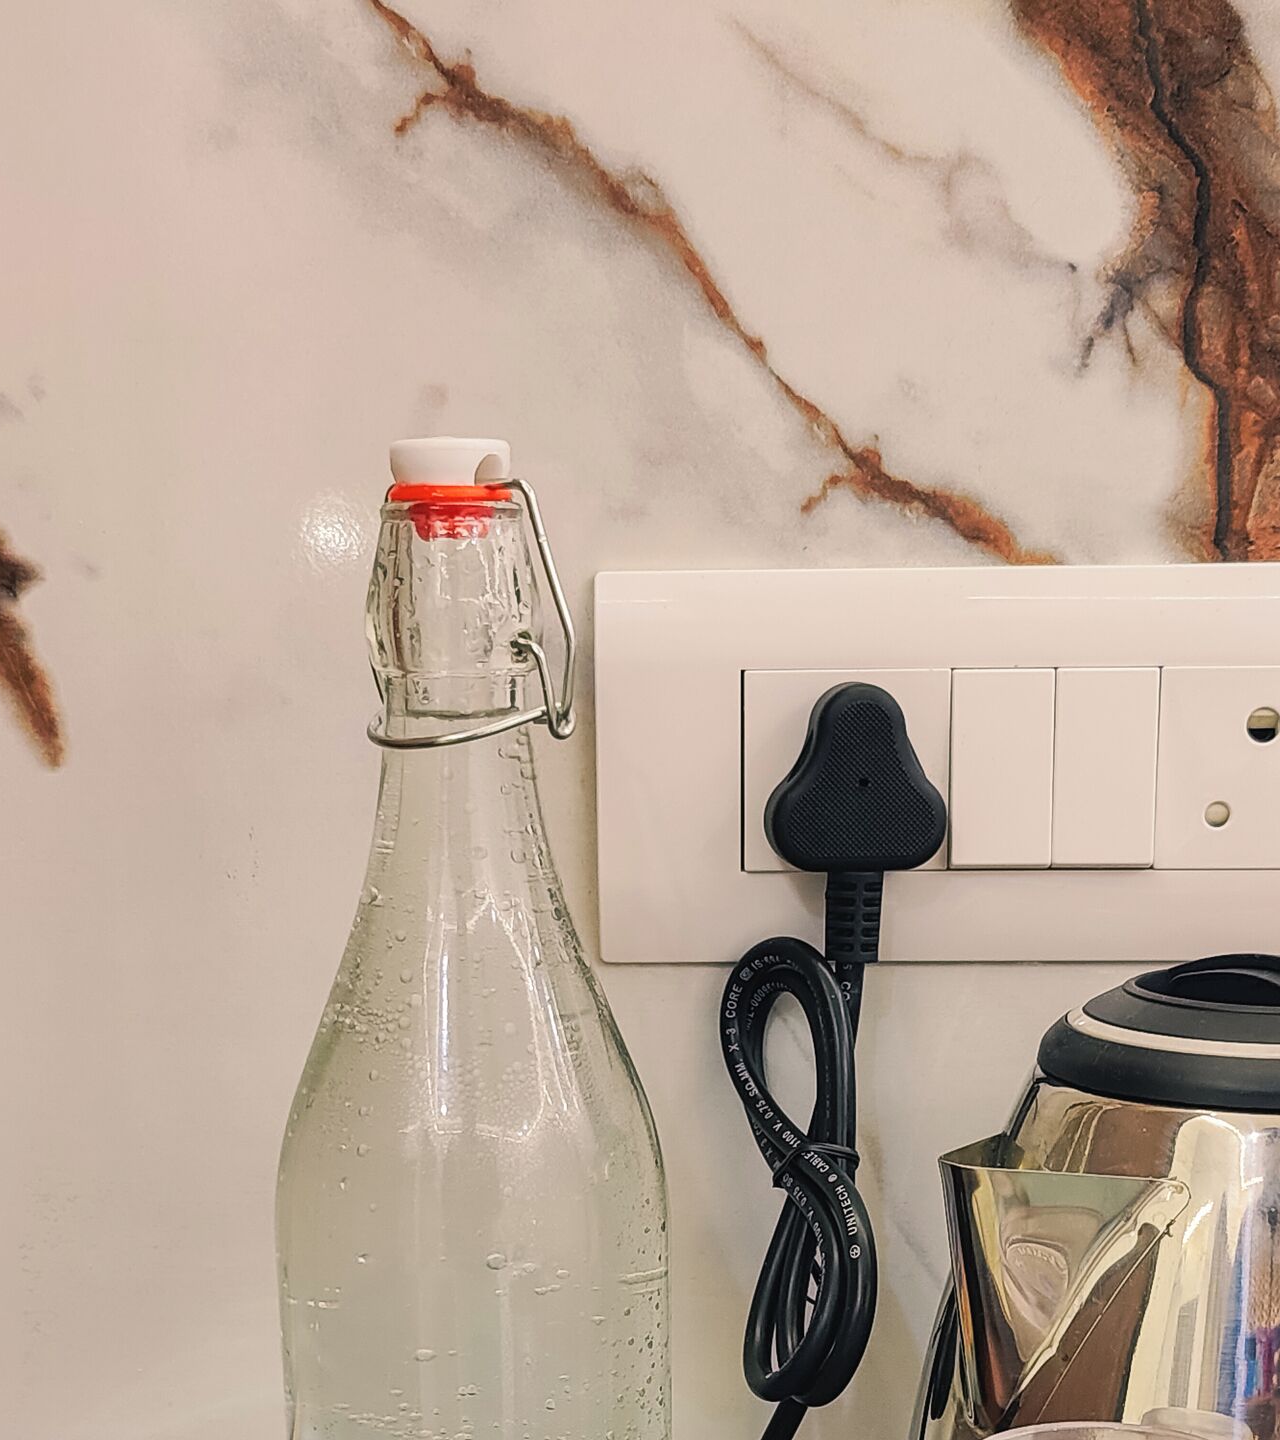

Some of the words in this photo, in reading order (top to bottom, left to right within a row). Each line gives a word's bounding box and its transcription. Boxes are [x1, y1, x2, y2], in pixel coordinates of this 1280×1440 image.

[725, 983, 743, 1018] CORE
[782, 1131, 801, 1148] 1100
[835, 1184, 858, 1235] UNITECH
